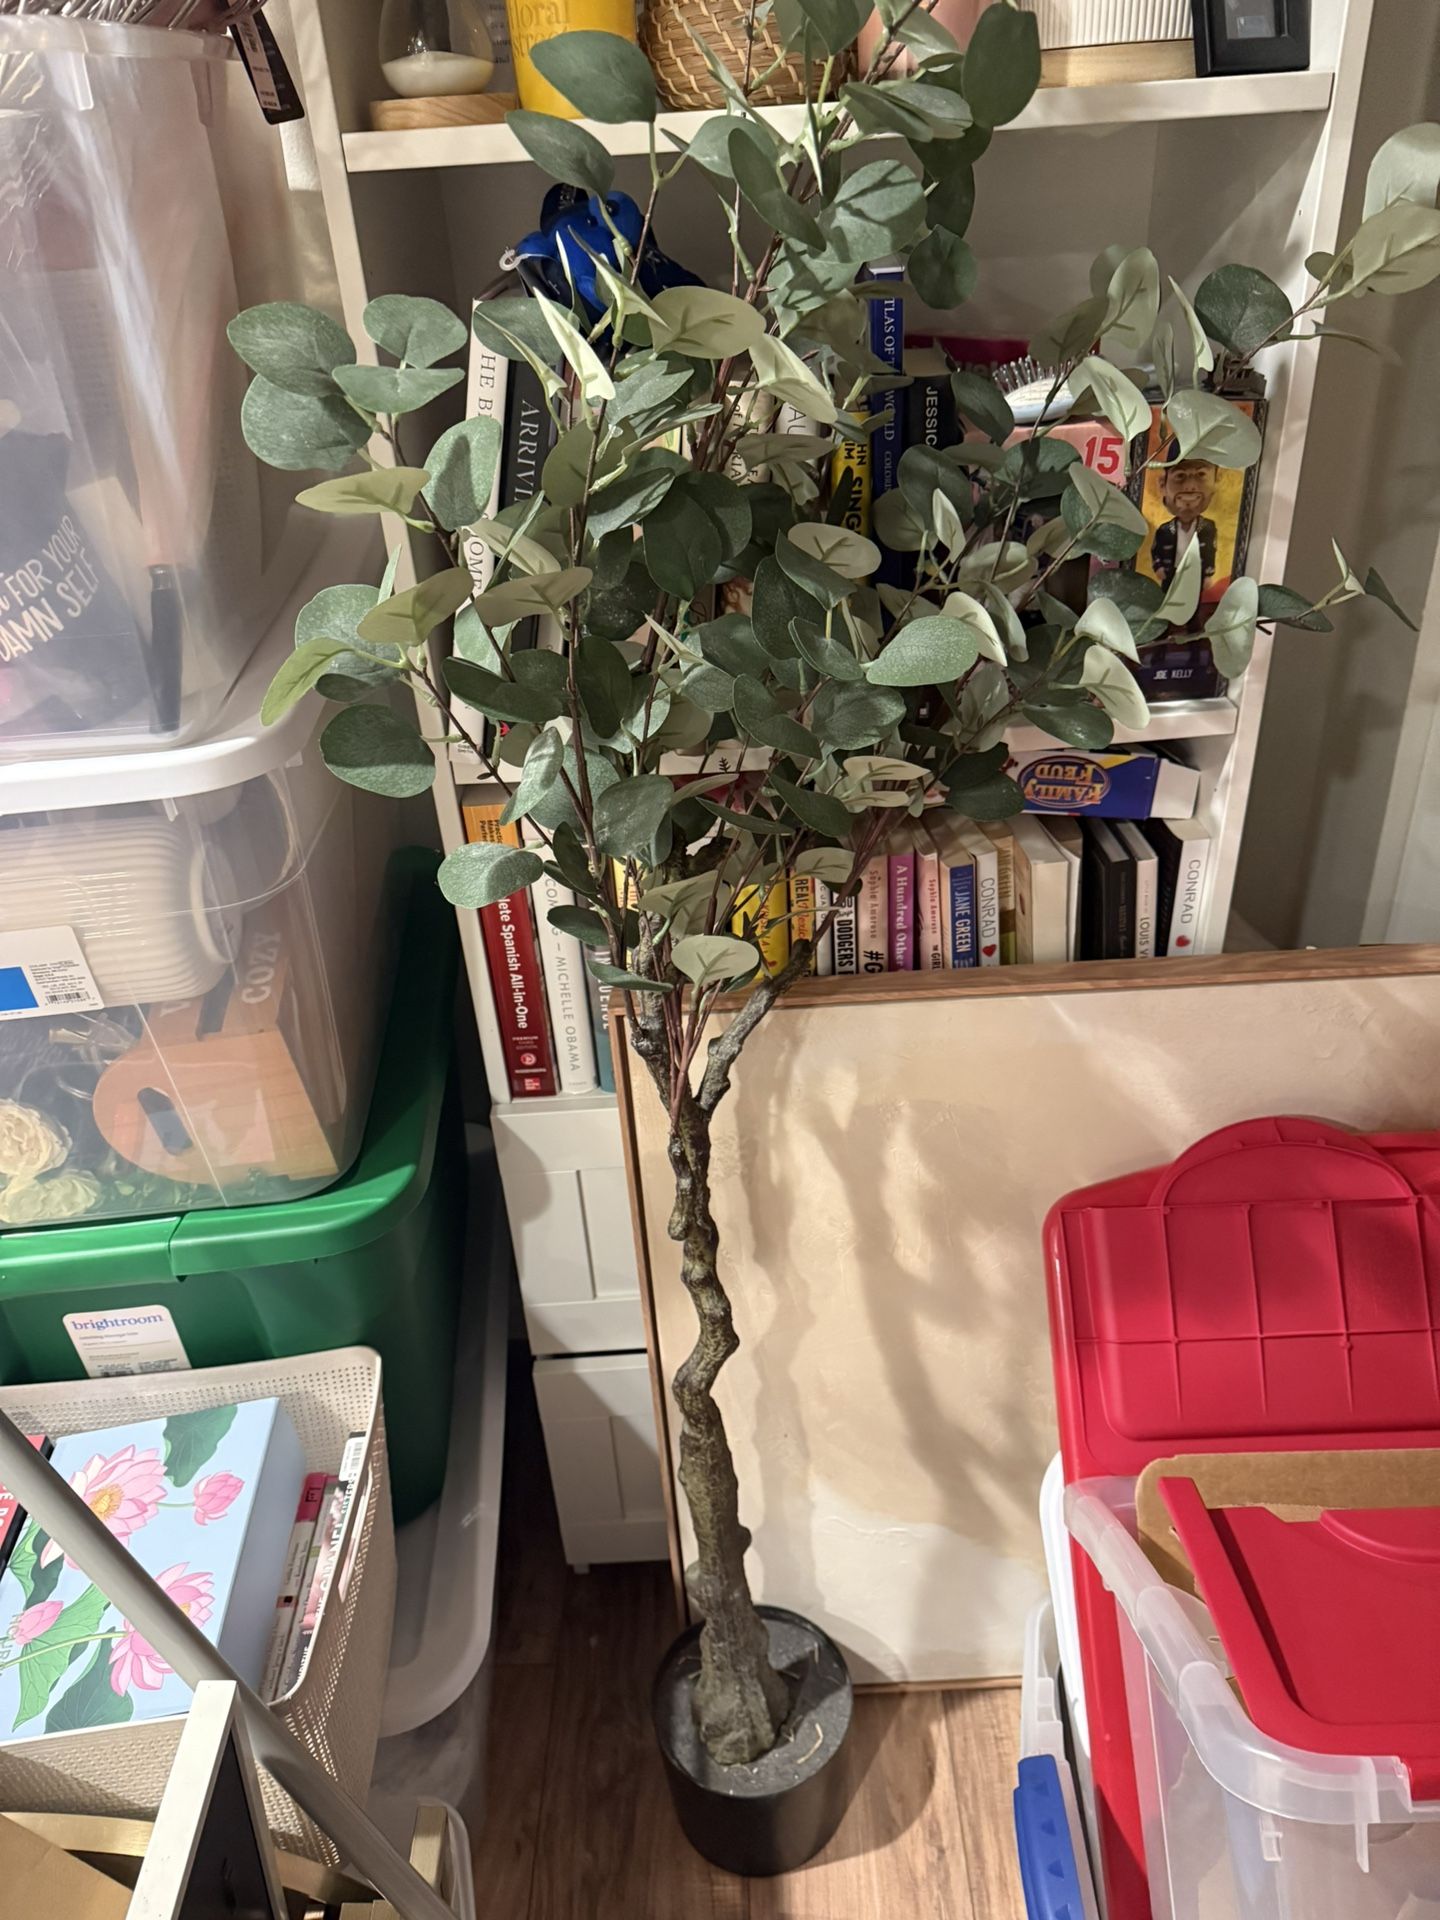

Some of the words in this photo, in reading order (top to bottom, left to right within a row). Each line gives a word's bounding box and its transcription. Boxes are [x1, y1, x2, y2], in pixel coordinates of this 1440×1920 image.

[884, 297, 896, 333] TLAS
[884, 336, 896, 355] OF
[480, 354, 496, 388] HE
[478, 398, 493, 417] B
[884, 389, 895, 441] WOLD
[925, 386, 938, 446] JESSIC
[514, 400, 540, 500] ARRIV
[844, 442, 855, 461] IM
[856, 443, 867, 466] HN
[1085, 436, 1124, 475] 15
[884, 451, 893, 490] COLORI
[845, 476, 863, 534] SING
[4, 559, 53, 607] FOR
[42, 515, 82, 572] YOUR
[468, 540, 484, 590] OME
[56, 547, 100, 618] SELF
[1171, 669, 1194, 679] KELLY
[1035, 763, 1097, 784] FEUD
[1024, 779, 1105, 805] FAMILY
[896, 865, 908, 874] A
[795, 878, 809, 904] REAL
[896, 877, 908, 930] Hundred
[954, 892, 971, 917] JANE
[980, 878, 997, 939] CONRAD
[1180, 859, 1201, 925] CONRAD
[498, 898, 511, 922] lete
[796, 903, 809, 940] Mexic
[500, 925, 521, 972] Spanish
[836, 919, 854, 968] DODGERS
[955, 919, 972, 953] GREEN
[1139, 916, 1150, 946] LOUIS
[241, 931, 282, 1004] COZY
[863, 950, 884, 974] #G
[896, 934, 908, 966] Other
[510, 973, 529, 1029] All-in-One
[555, 956, 574, 1020] MICHELLE
[565, 1026, 581, 1071] OBAMA
[71, 1314, 163, 1331] brightroom
